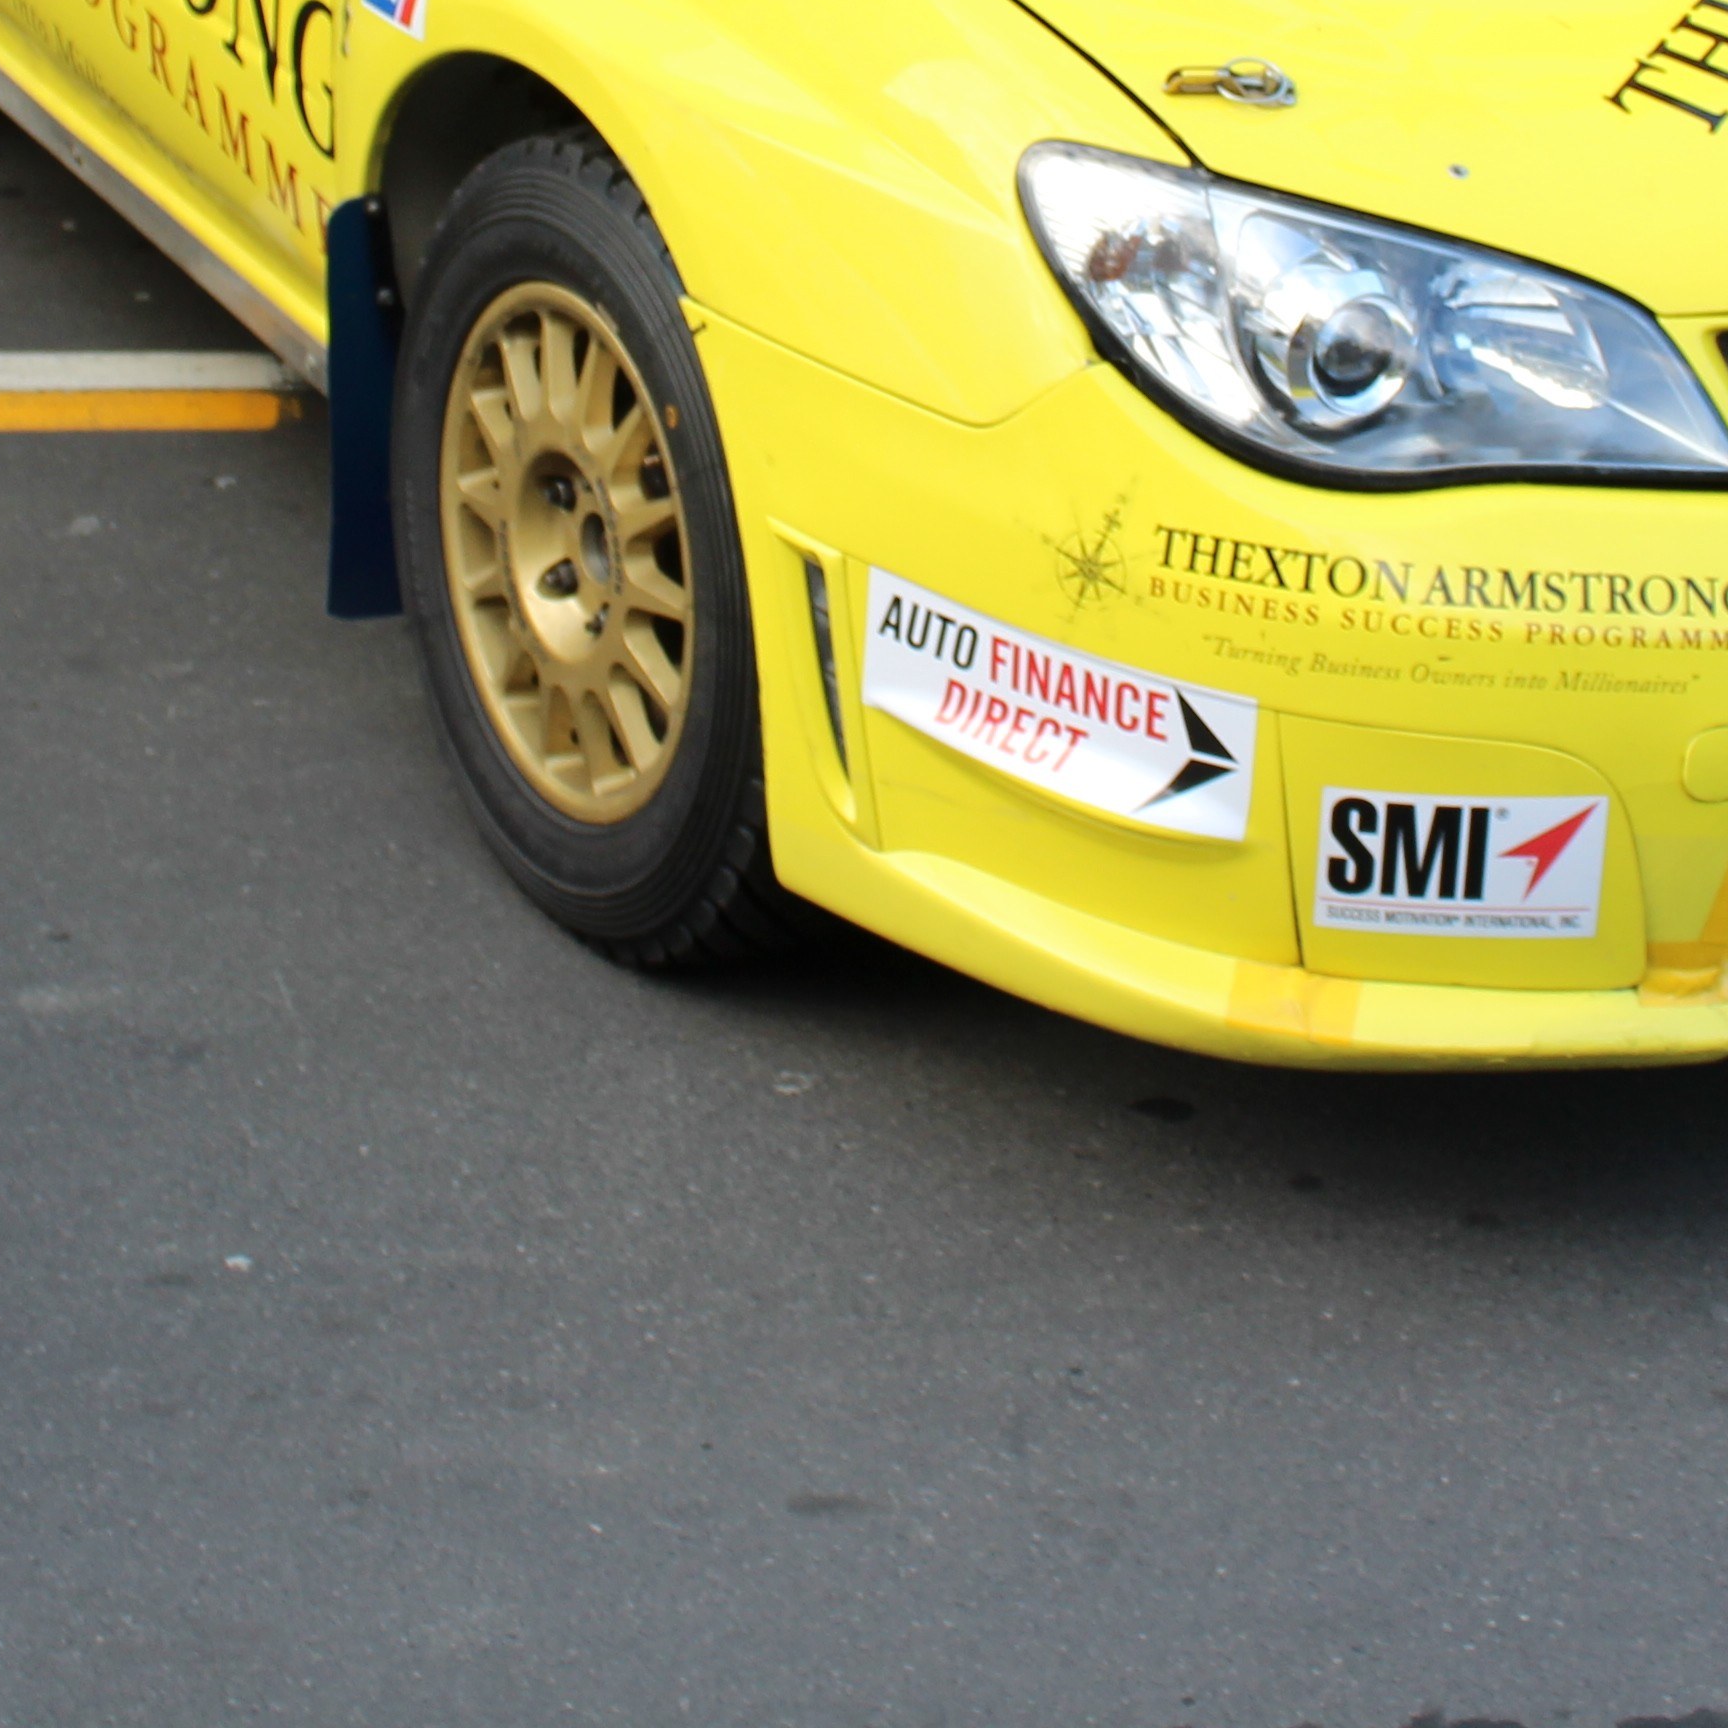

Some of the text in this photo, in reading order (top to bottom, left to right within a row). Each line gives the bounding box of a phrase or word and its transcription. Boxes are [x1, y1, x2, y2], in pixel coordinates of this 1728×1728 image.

[1152, 524, 1416, 606] THEXTON
[1148, 575, 1321, 629] BUSINESS
[1339, 607, 1506, 645] SUCCESS
[879, 593, 1171, 743] AUTO FINANCE
[1307, 651, 1403, 686] Business
[1409, 660, 1495, 692] Owners
[1502, 668, 1550, 692] into
[933, 677, 1091, 774] DIRECT
[1327, 796, 1491, 901] SMI
[1326, 905, 1381, 923] SUCCESS
